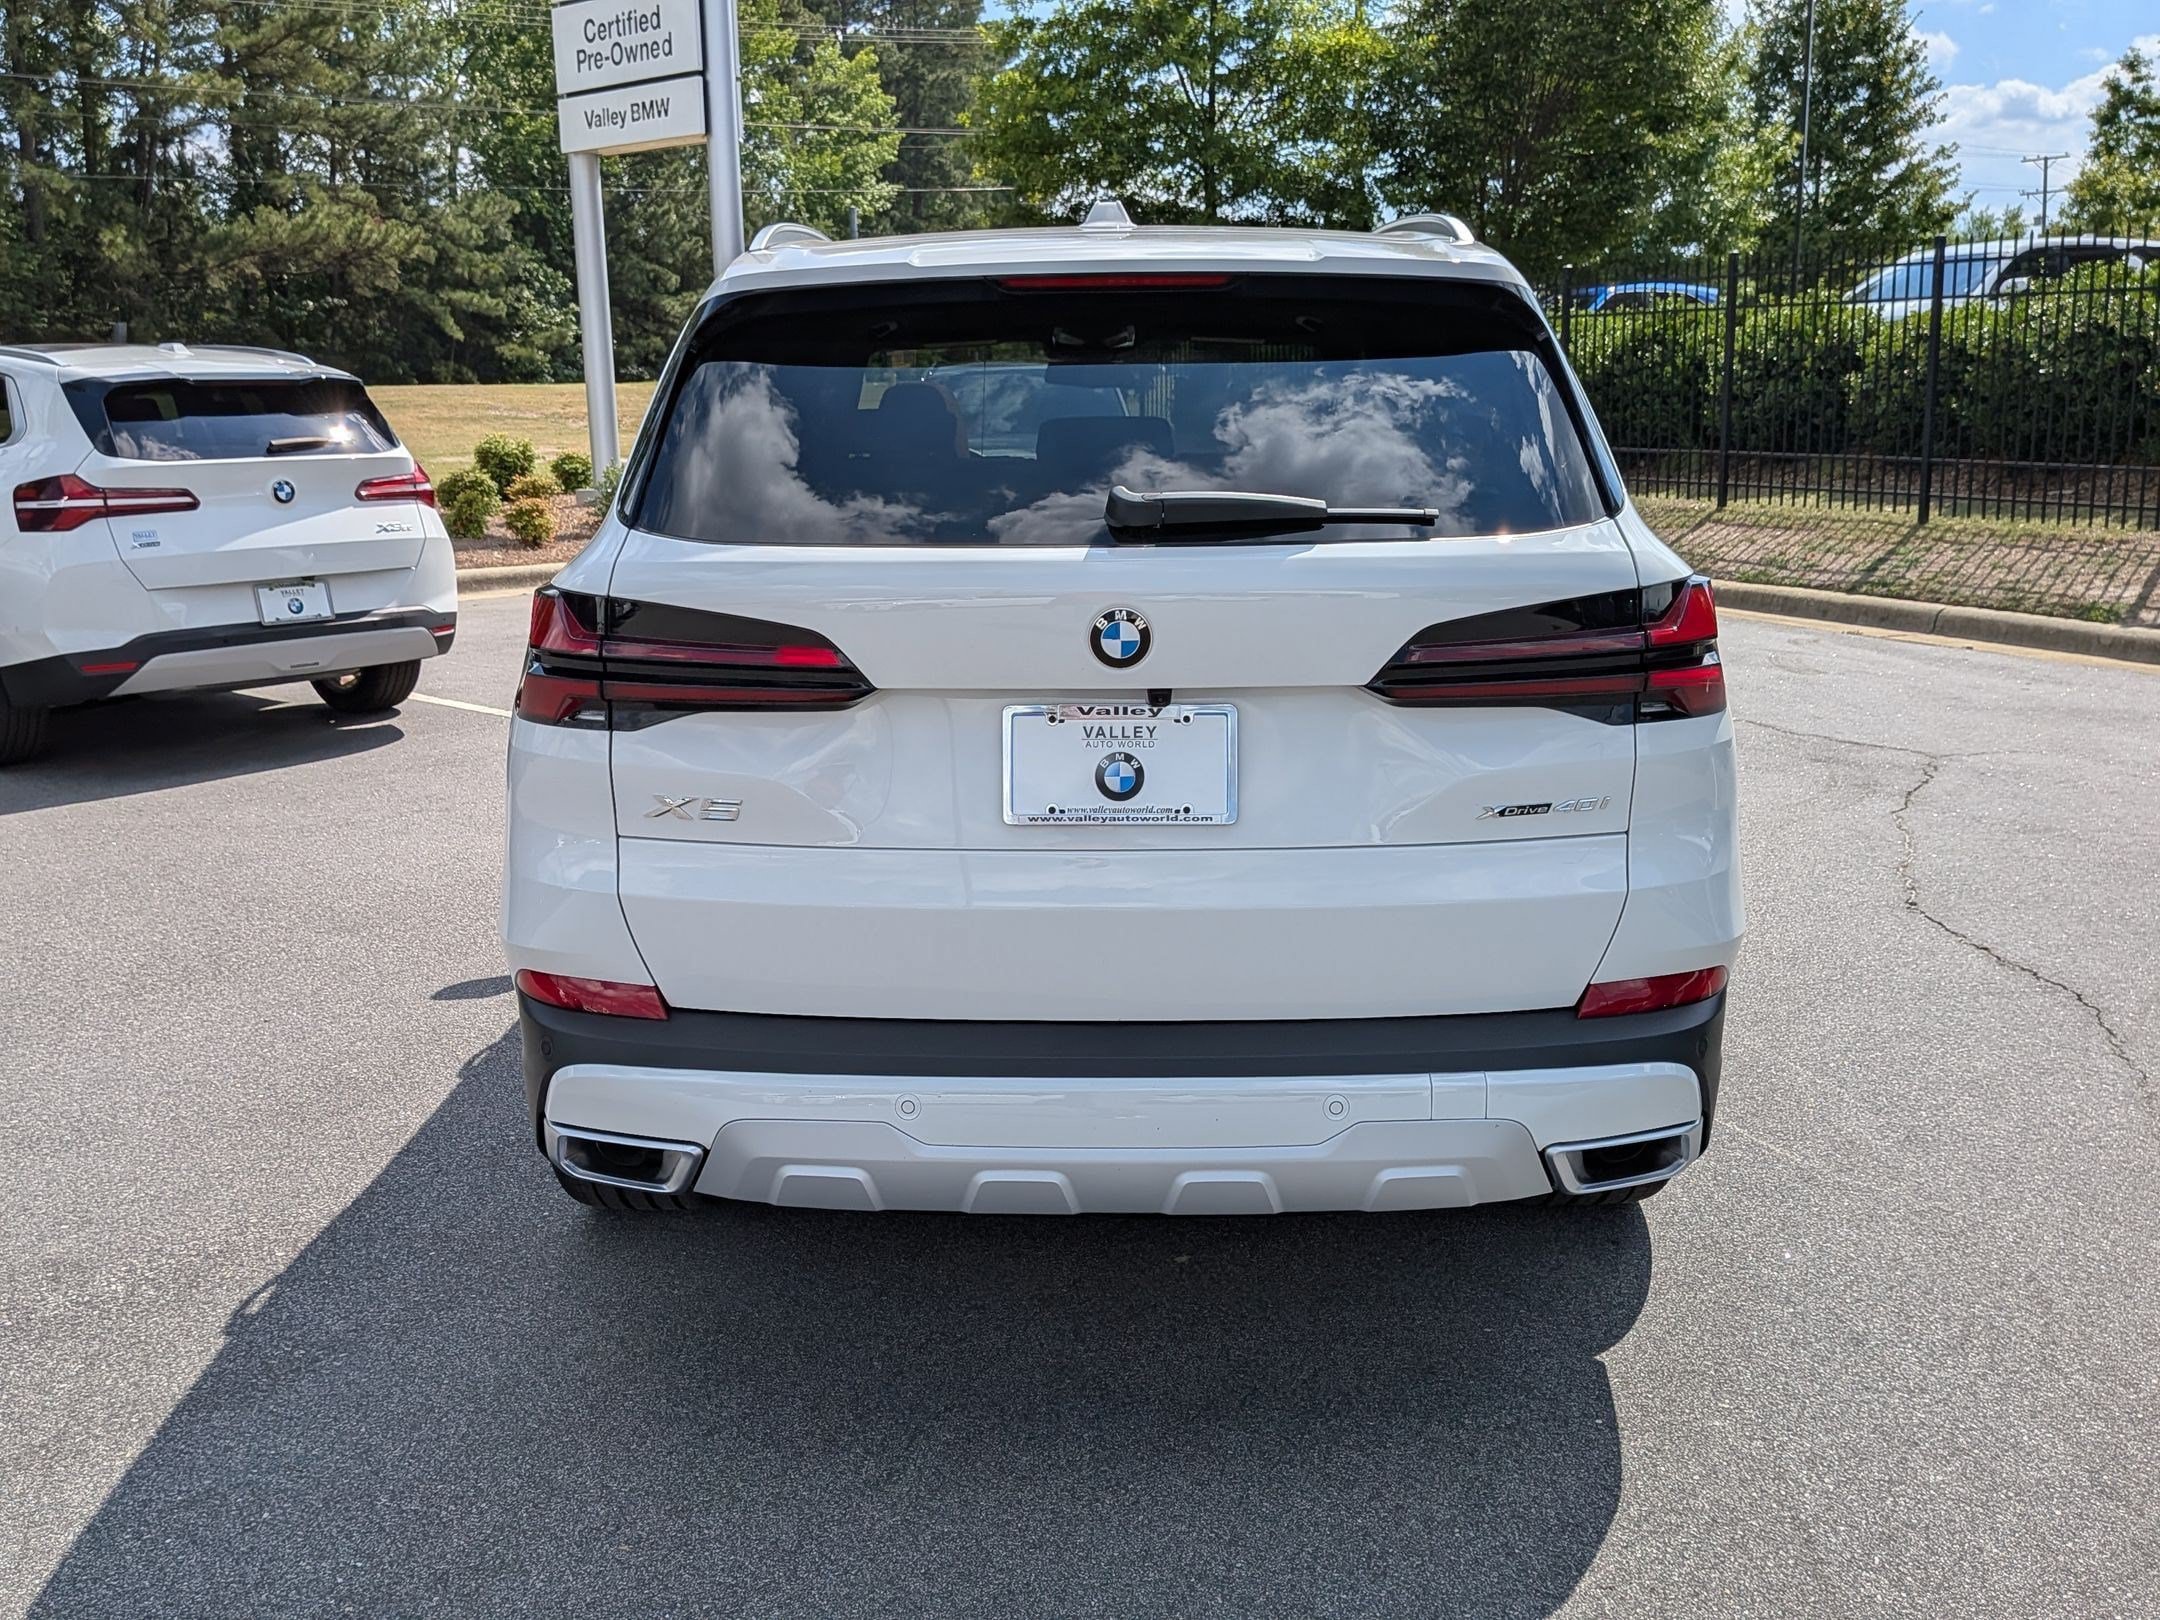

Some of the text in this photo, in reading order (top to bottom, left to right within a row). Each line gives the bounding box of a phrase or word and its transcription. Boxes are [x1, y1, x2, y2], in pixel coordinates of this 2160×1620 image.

[583, 4, 661, 43] Certified
[576, 32, 673, 73] Pre-Owned
[584, 97, 670, 129] Valley BMW
[1095, 610, 1147, 630] BMW
[1077, 706, 1163, 718] Valley
[1083, 726, 1157, 739] VALLEY
[1085, 740, 1155, 749] AUTO WORLD
[1099, 752, 1141, 769] BMW
[643, 793, 743, 821] X5
[1028, 814, 1213, 824] www.valleyautoworld.com
